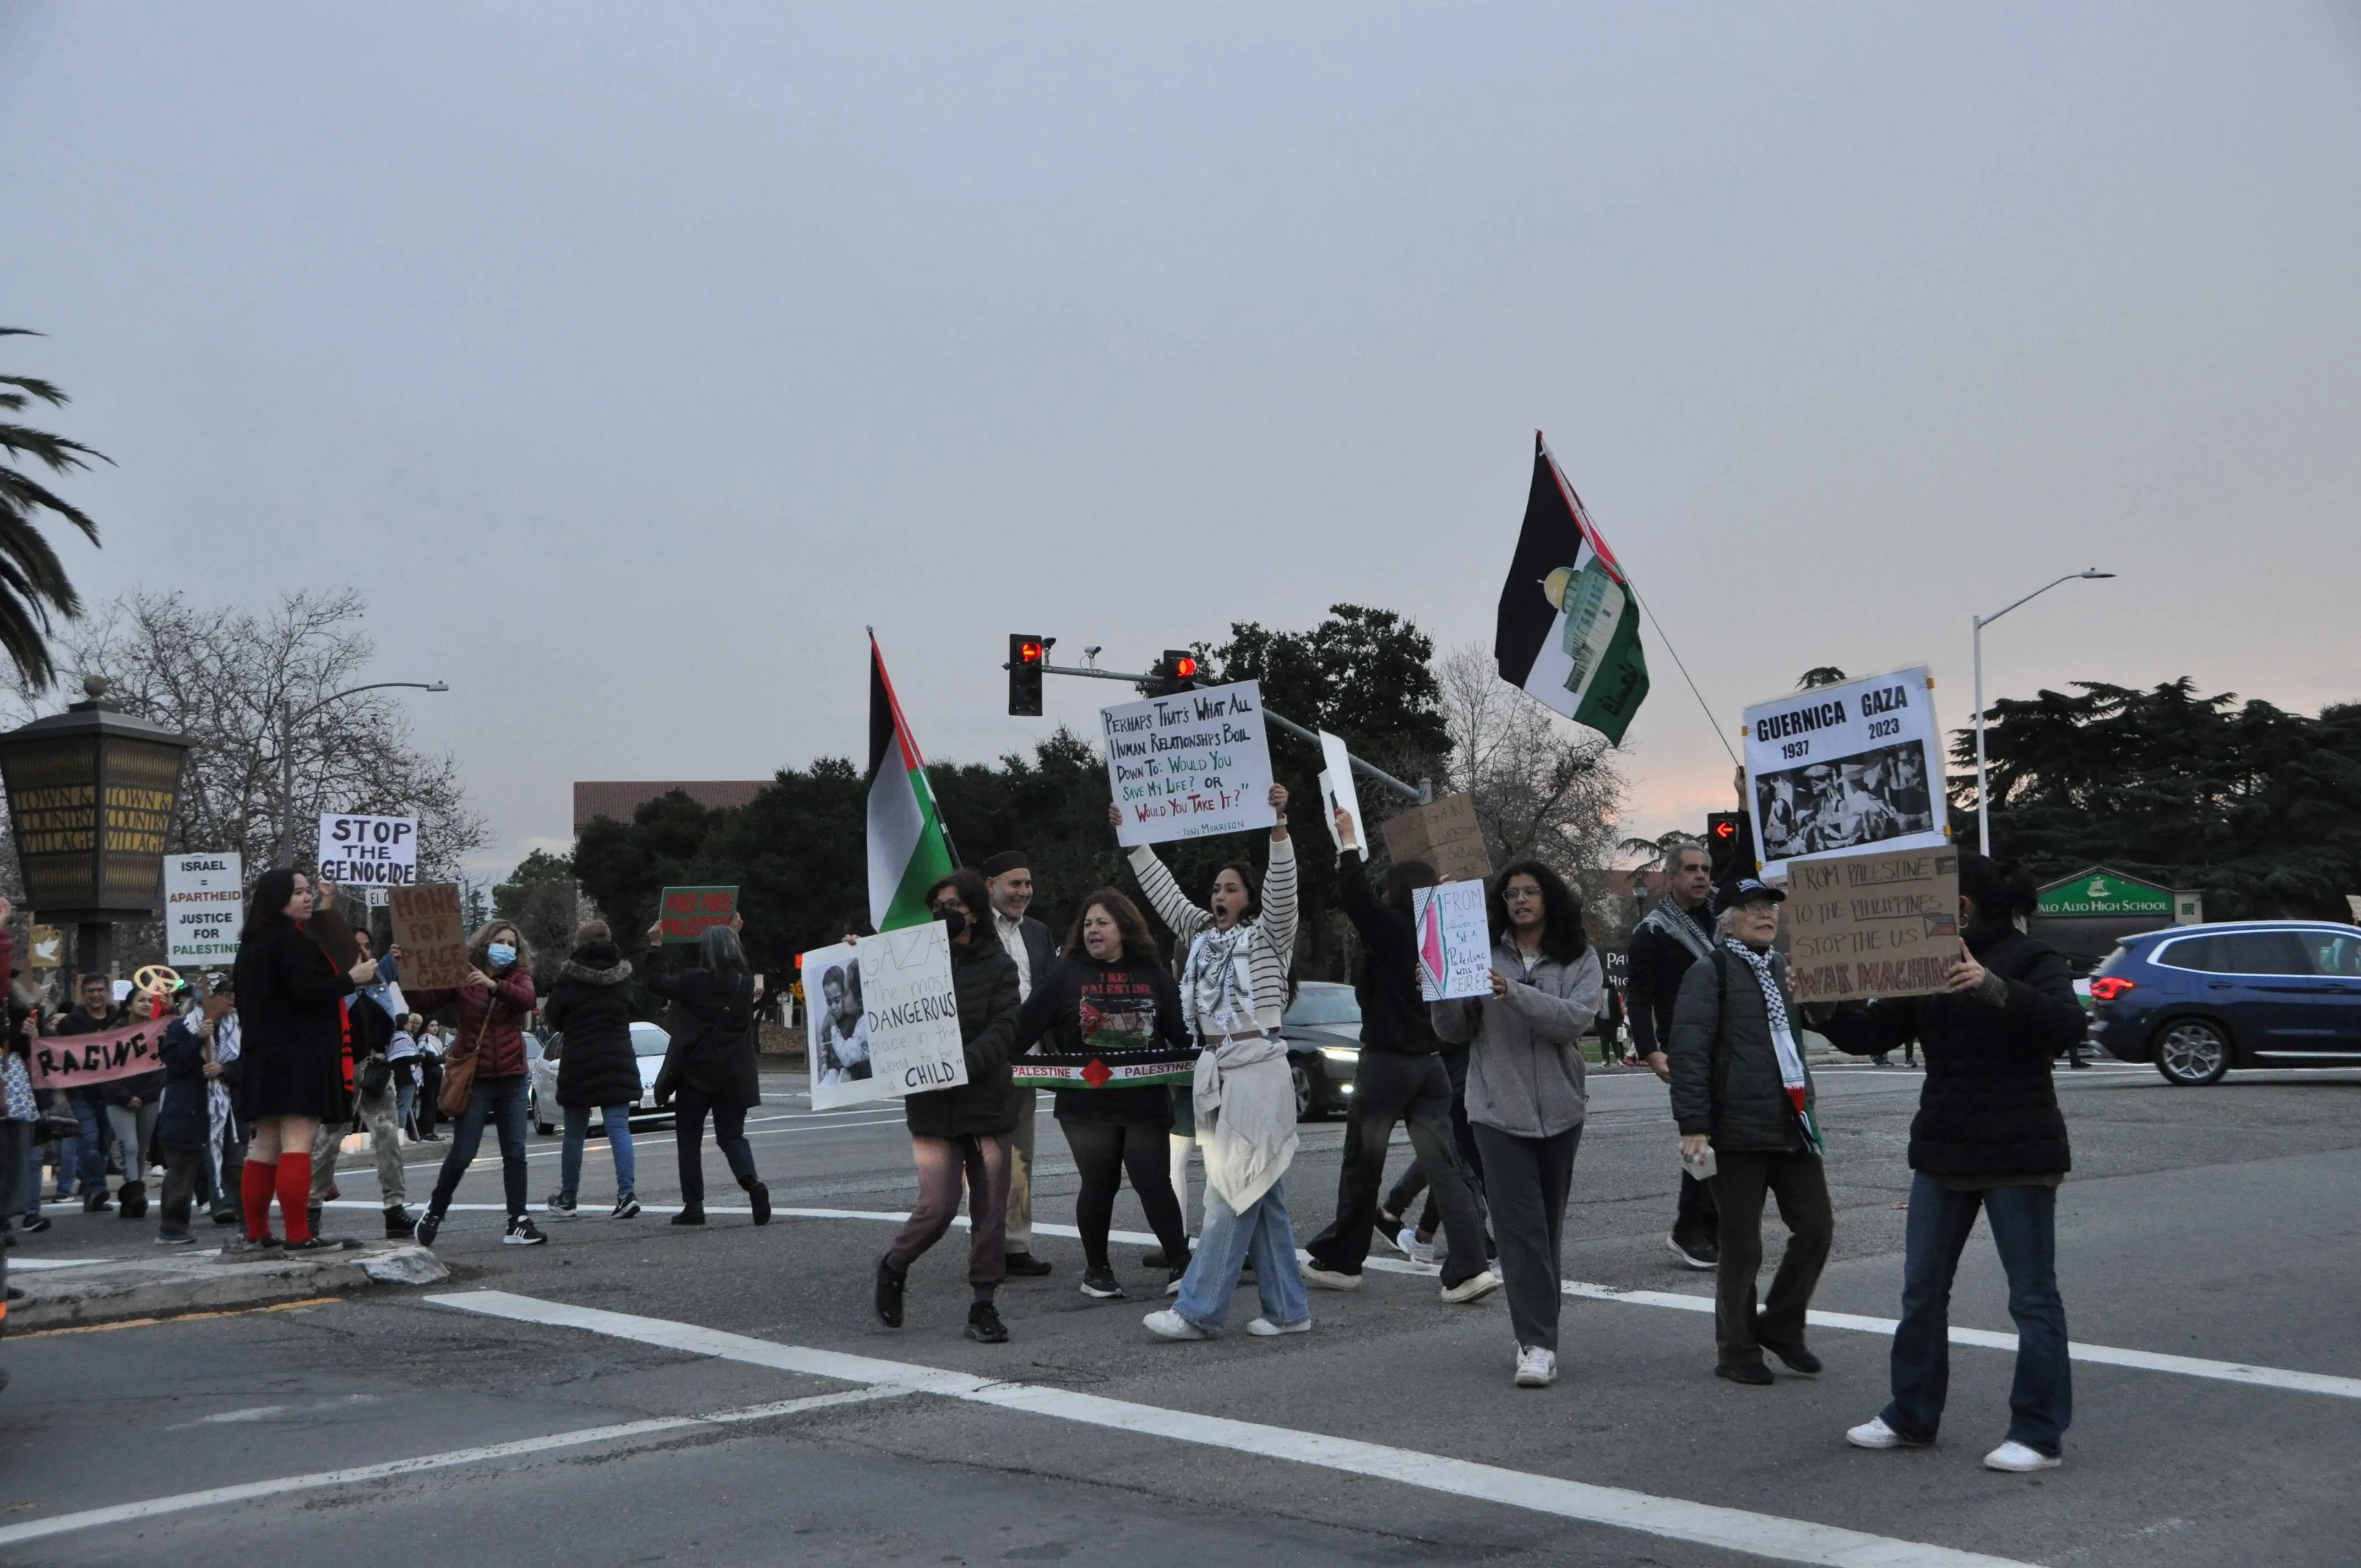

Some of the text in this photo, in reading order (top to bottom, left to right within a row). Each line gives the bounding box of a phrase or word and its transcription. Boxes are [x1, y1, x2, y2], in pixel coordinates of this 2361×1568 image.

[1756, 685, 1908, 743] GUERNICA GAZA
[1110, 738, 1146, 760] HUMAN
[1781, 717, 1900, 760] 1937 2023
[1167, 755, 1206, 774] WOULD
[1209, 750, 1231, 770] YOU
[107, 786, 155, 809] TOWN
[1123, 786, 1145, 801] SAVE
[1204, 776, 1223, 788] OR
[107, 809, 168, 831] COUNTRY
[1135, 803, 1166, 823] WOULD
[1168, 798, 1187, 817] YOU
[1188, 794, 1215, 814] TAKE
[331, 819, 412, 844] STOP
[1201, 820, 1244, 834] MORRISON
[106, 831, 165, 852] VILLAGE
[342, 845, 391, 859] THE
[181, 861, 227, 872] ISRAEL
[321, 860, 414, 884] GENOCIDE
[1792, 857, 1934, 890] FROM PALESTINE
[170, 891, 241, 902] APARTHEID
[393, 886, 461, 918] HONK
[666, 892, 733, 914] FREE FREE
[1443, 889, 1482, 914] FROM
[2062, 901, 2089, 911] ALTO
[2092, 901, 2119, 911] HIGH
[2123, 900, 2167, 911] SCHOOL
[179, 913, 232, 924] JUSTICE
[1792, 895, 1942, 924] TO THE PHILIPPINES
[194, 929, 219, 939] FOR
[409, 919, 448, 943] FOR
[1456, 929, 1478, 944] SEA
[173, 943, 241, 955] PALESTINE
[861, 926, 948, 976] GAZA:
[1797, 934, 1845, 957] STOP
[1848, 930, 1881, 952] THE
[401, 944, 464, 968] PEACE
[911, 966, 949, 997] most
[1451, 972, 1489, 994] FREE
[1796, 962, 1854, 998] WAR
[868, 992, 956, 1033] DANGEROUS
[36, 1032, 149, 1076] RAGING
[871, 1025, 957, 1059] place in the
[879, 1048, 953, 1074] world to be
[1011, 1066, 1071, 1077] PALESTINE
[1124, 1061, 1193, 1077] PALESTINE
[889, 1082, 895, 1091] a
